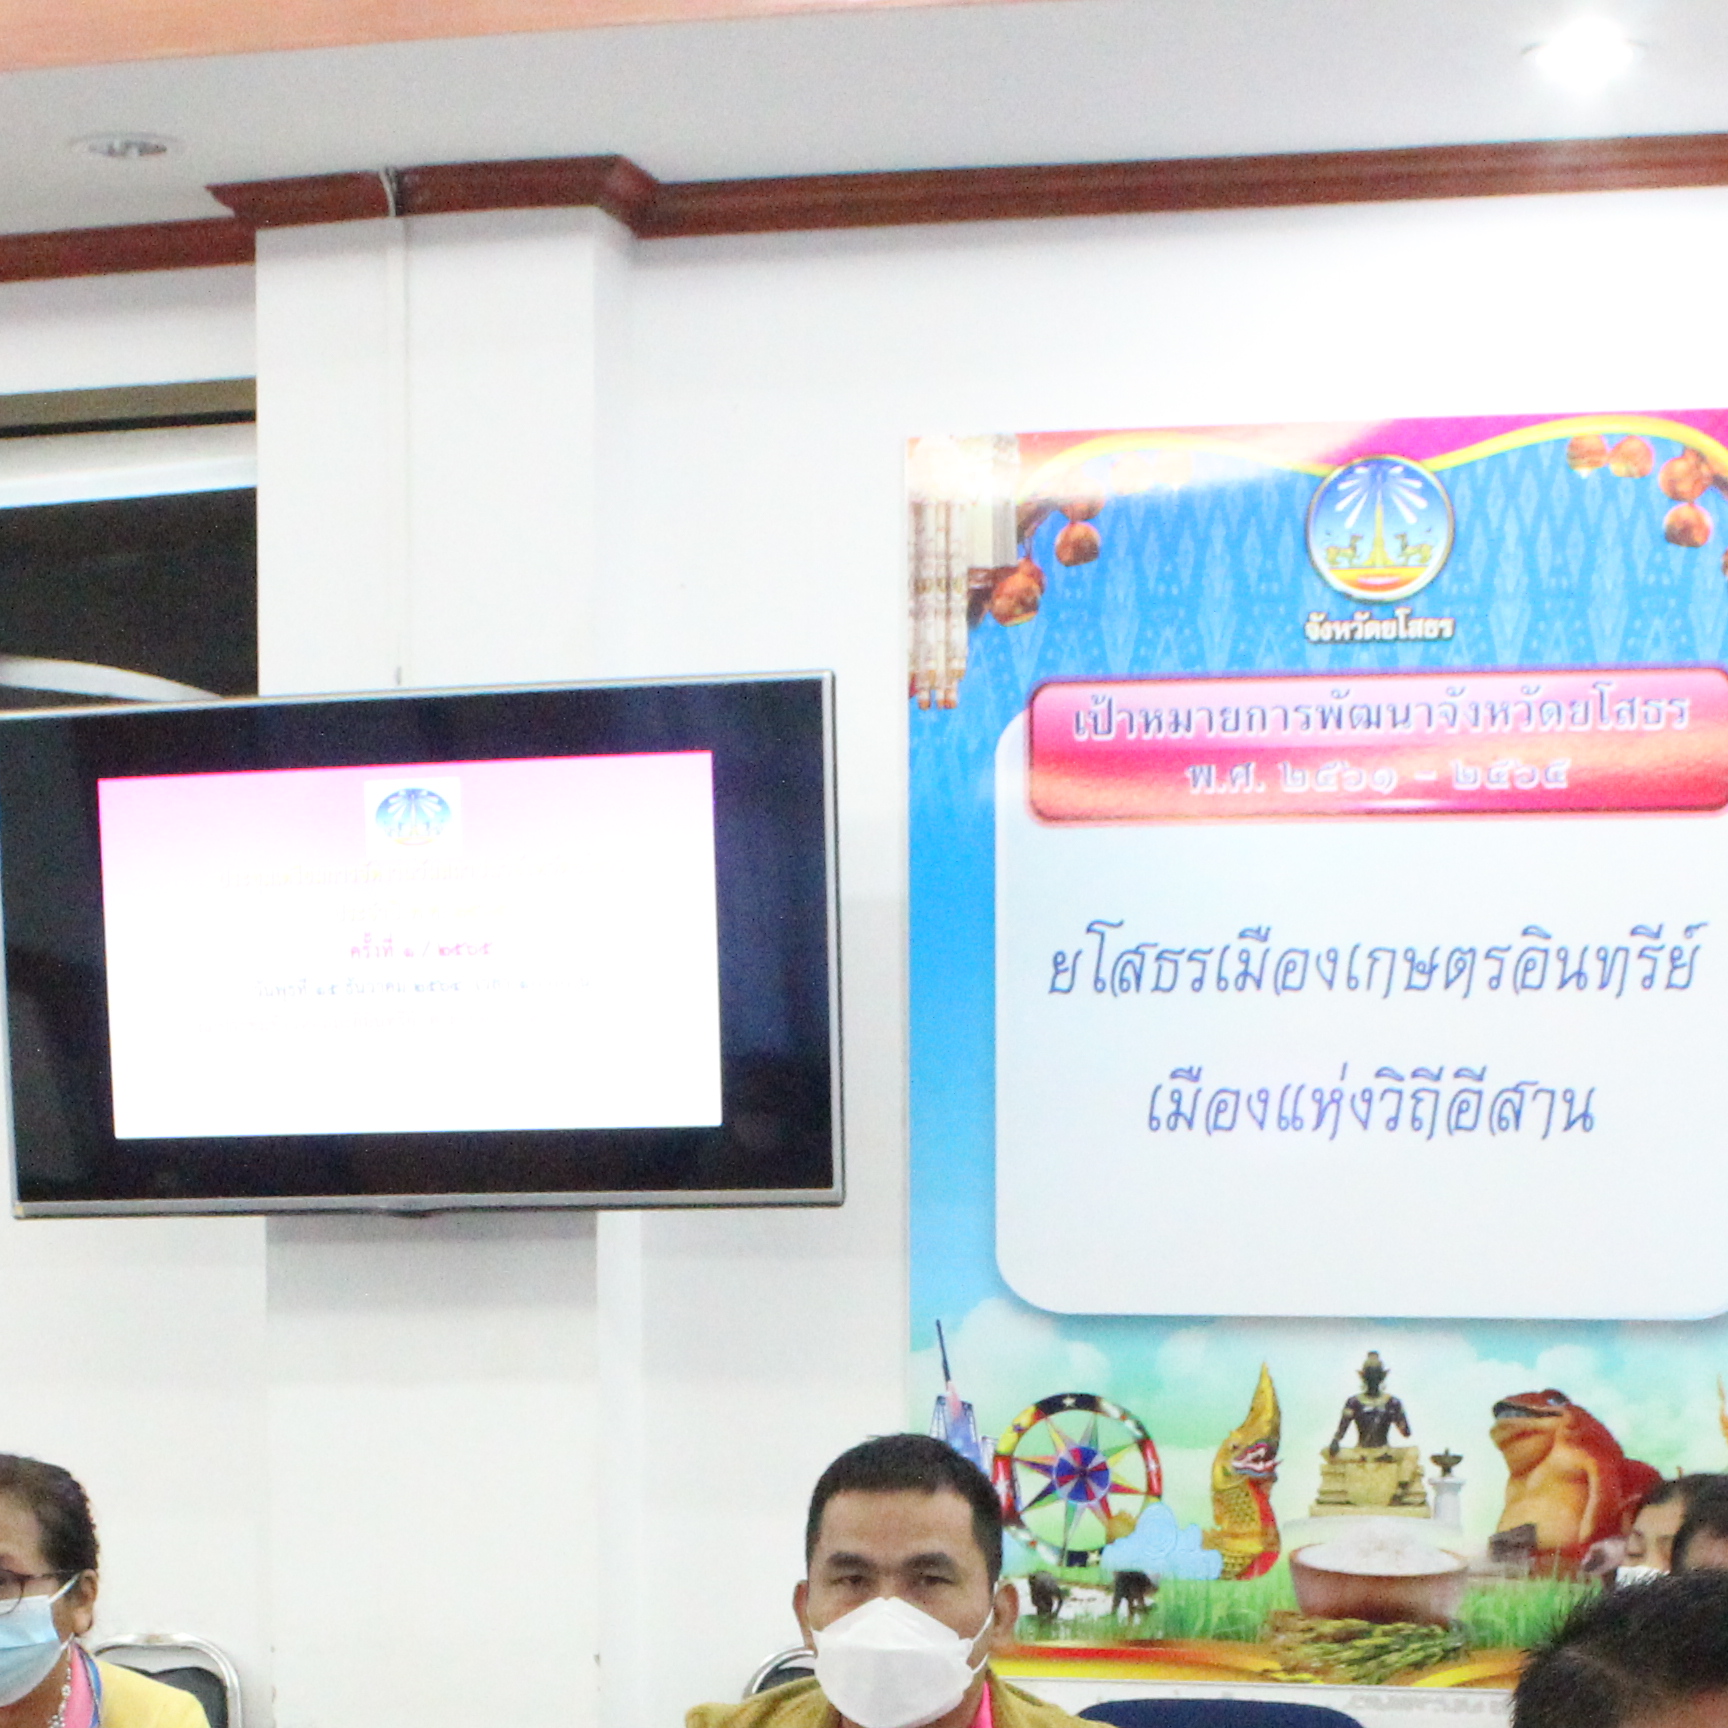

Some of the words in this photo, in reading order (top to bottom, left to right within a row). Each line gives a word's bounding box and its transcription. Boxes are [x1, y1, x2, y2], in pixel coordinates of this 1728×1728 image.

[1305, 608, 1455, 643] จังหวัดยโสธร
[1072, 682, 1691, 740] เป้าหมายการพัฒนาจังหวัดยโสธร
[1185, 760, 1265, 794] พ.ศ.
[1048, 917, 1707, 1000] ยโสธรเมืองเกษตรอินทรีย์
[1147, 1062, 1596, 1142] เมืองแห่งวิถีอีสาน
